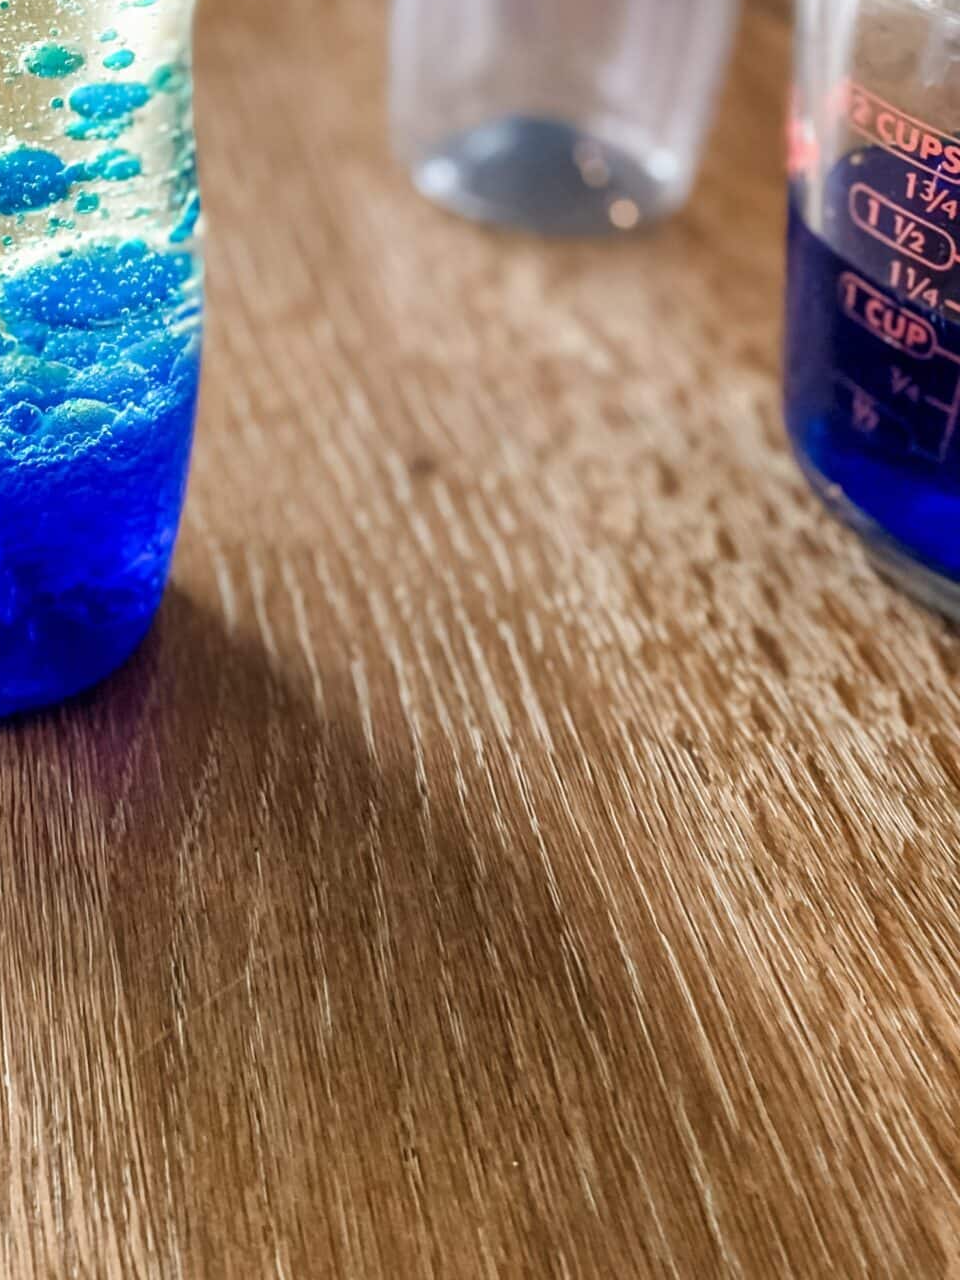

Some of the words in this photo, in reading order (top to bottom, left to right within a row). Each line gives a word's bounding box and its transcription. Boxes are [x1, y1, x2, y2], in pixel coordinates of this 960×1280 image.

[876, 112, 960, 174] CUPS
[846, 283, 856, 311] 1
[865, 298, 928, 347] CUP
